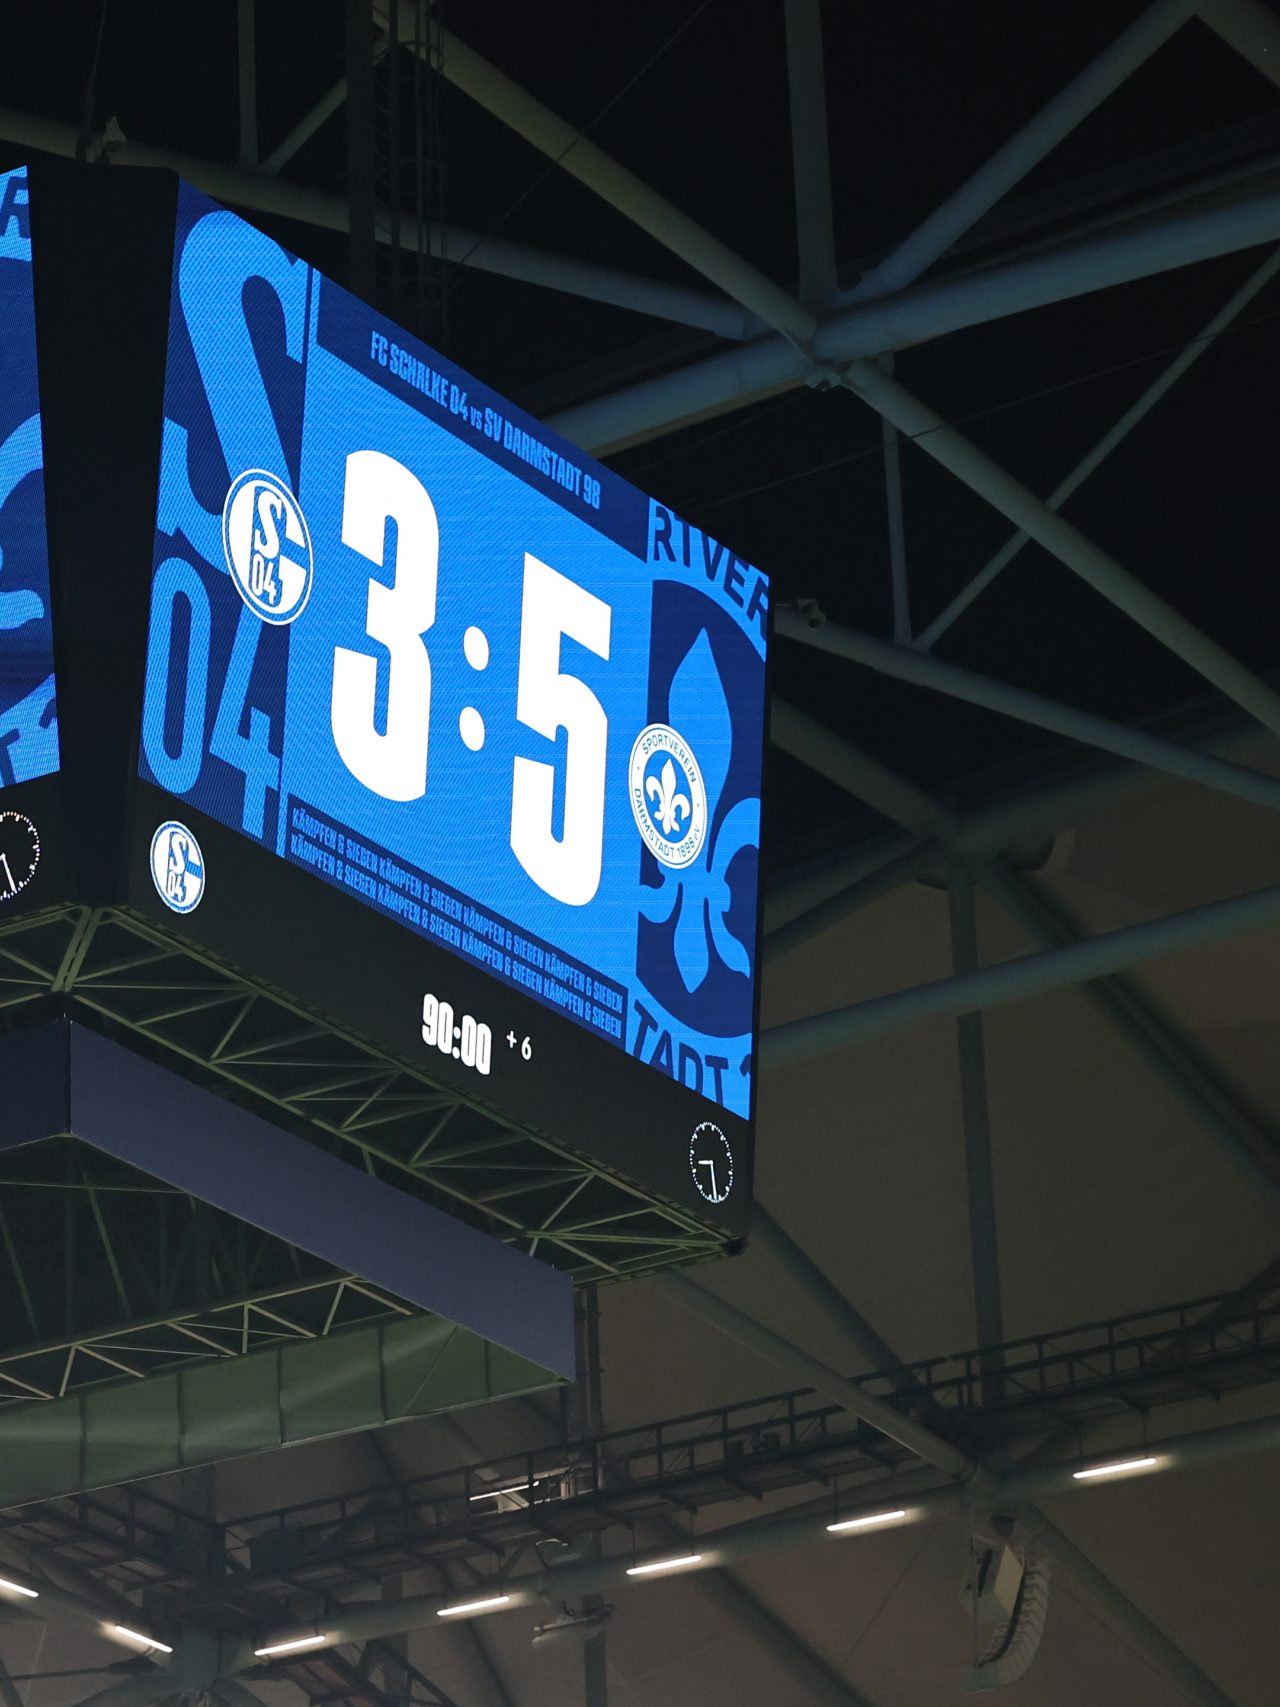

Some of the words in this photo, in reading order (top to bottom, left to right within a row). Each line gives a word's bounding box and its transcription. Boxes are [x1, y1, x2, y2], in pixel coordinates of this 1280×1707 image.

[370, 331, 388, 367] FC
[390, 343, 448, 408] SCHALKE
[450, 384, 469, 421] 04
[484, 407, 503, 443] SV
[504, 421, 582, 497] DARMSTADT
[583, 474, 600, 510] 98
[642, 734, 696, 783] SPORTVEREIN
[634, 788, 674, 859] DARMSTADT
[344, 864, 376, 900] SIEGEN
[429, 913, 461, 948] SIEGEN
[512, 960, 543, 994] SIEGEN
[592, 1006, 622, 1039] SIEGEN
[346, 839, 378, 874] SIEGEN
[431, 888, 462, 922] SIEGEN
[513, 934, 544, 969] SIEGEN
[593, 981, 622, 1014] SIEGEN
[422, 993, 492, 1076] 90:00
